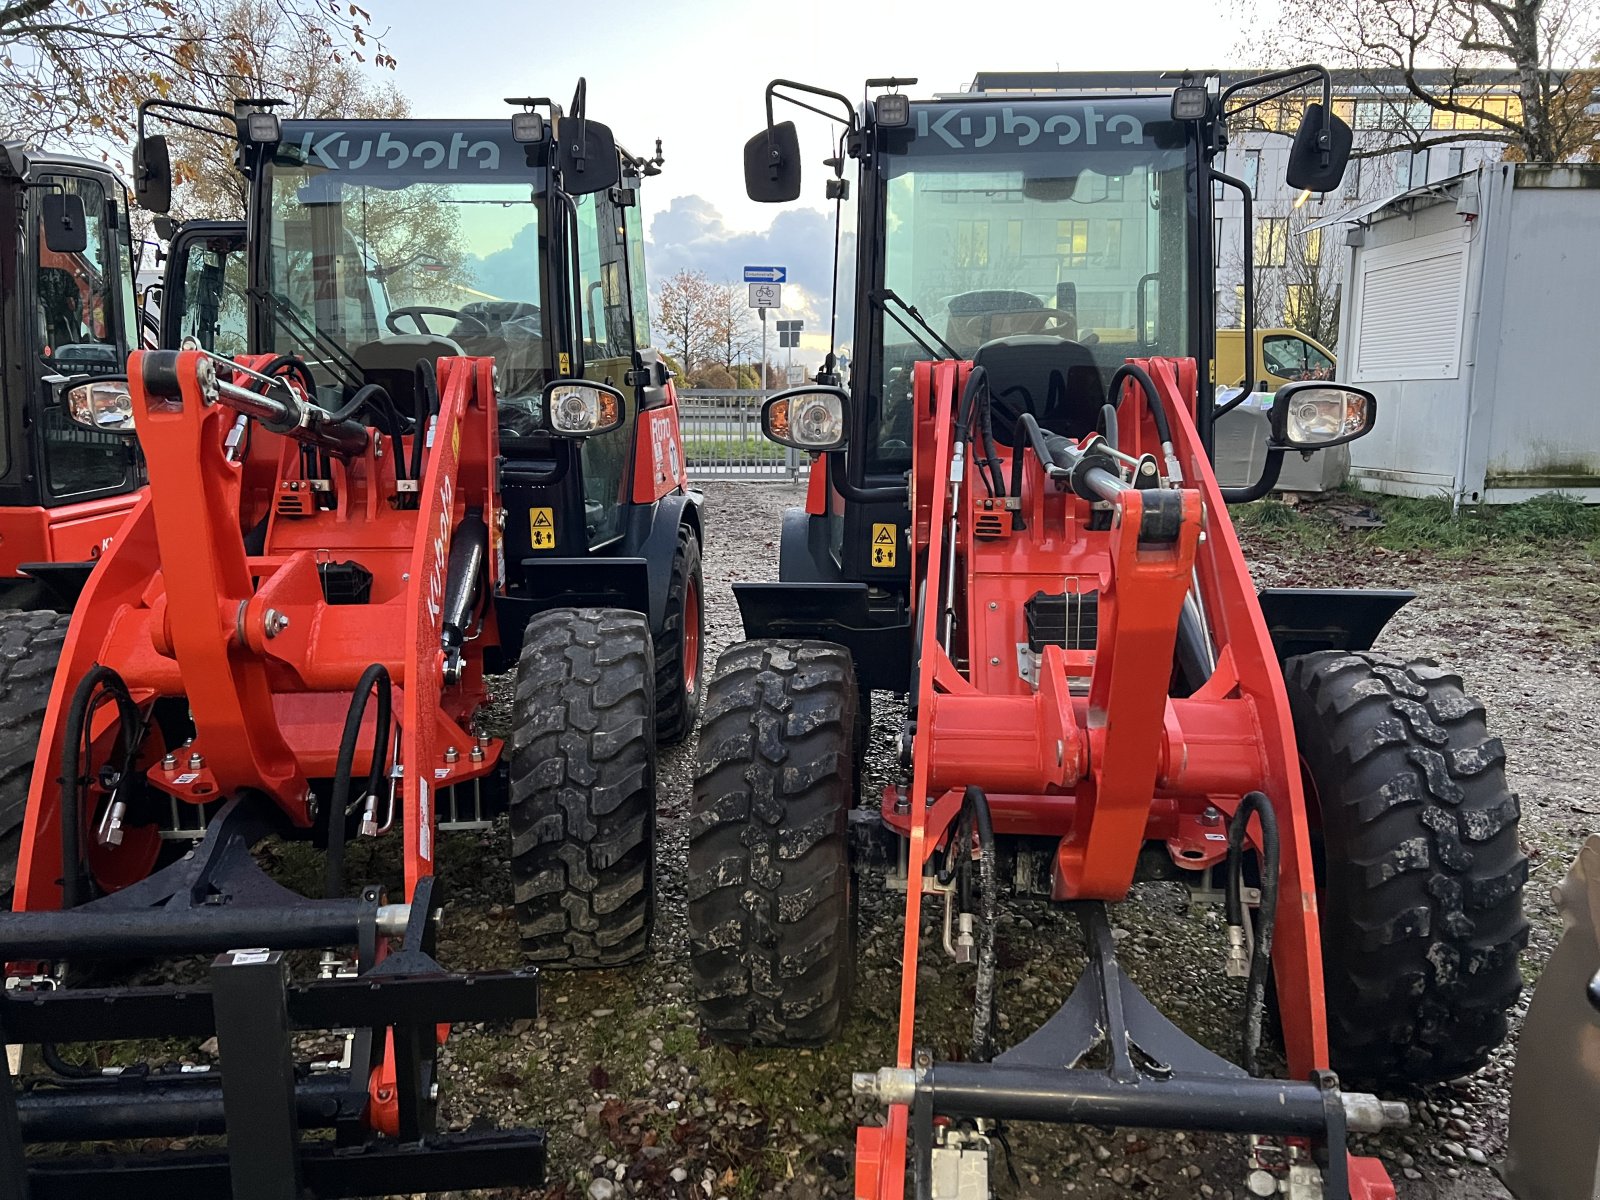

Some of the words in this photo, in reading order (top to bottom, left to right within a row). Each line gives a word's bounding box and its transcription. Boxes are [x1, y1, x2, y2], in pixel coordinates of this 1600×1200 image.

[916, 106, 1144, 149] Kubota
[301, 131, 500, 170] Kubota
[427, 475, 452, 628] Kubota
